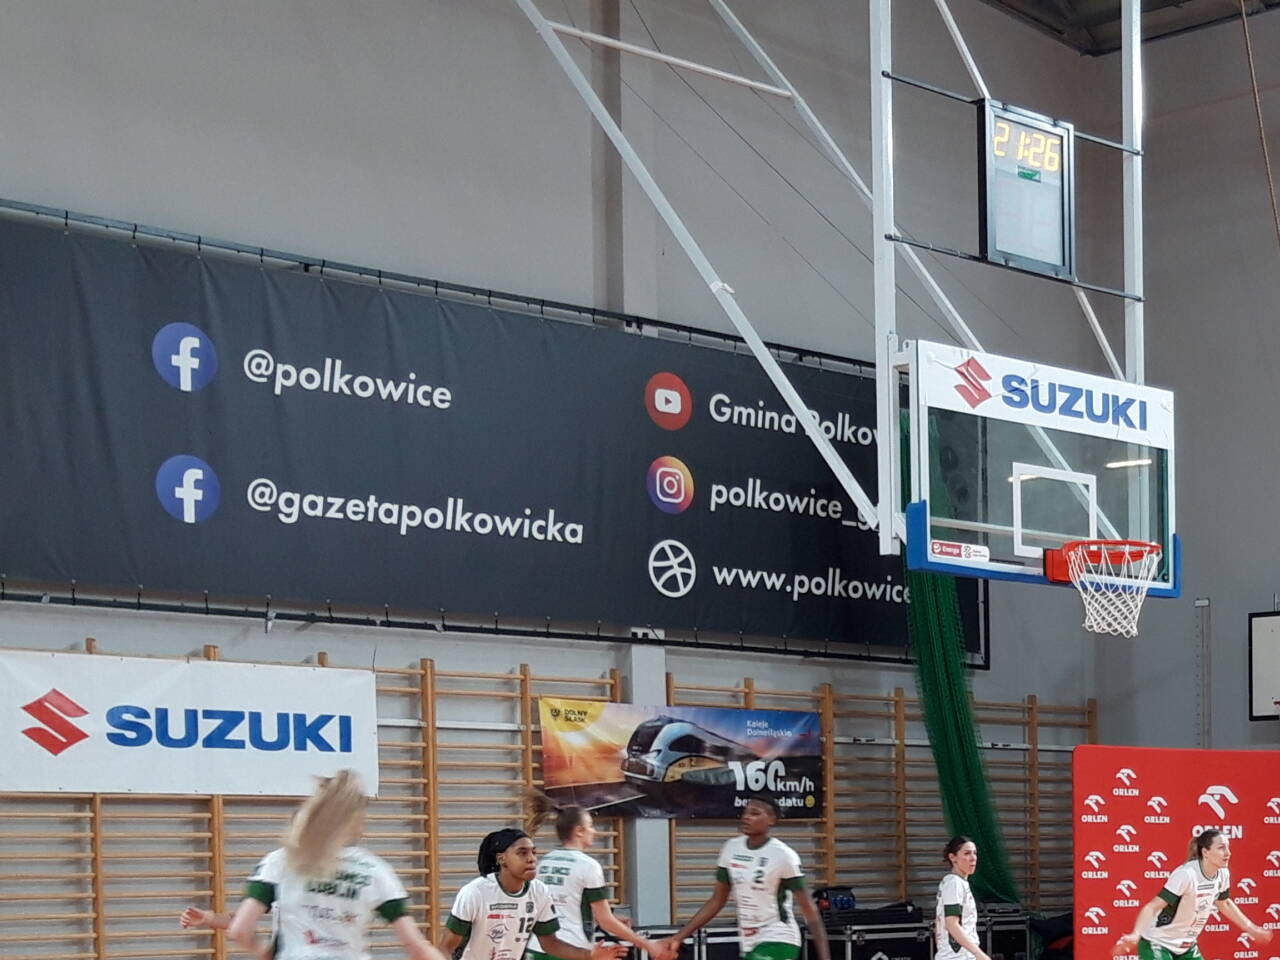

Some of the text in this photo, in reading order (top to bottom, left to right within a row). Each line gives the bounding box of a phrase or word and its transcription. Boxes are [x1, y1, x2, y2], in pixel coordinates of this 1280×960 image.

[992, 122, 1061, 172] 21:26
[243, 348, 452, 410] @polkowice
[1001, 374, 1147, 431] SUZUKI
[709, 393, 797, 434] Gmina
[247, 477, 584, 544] @gazetapolkowicka
[106, 705, 352, 753] SUZUKI
[727, 760, 815, 793] 160 km/h
[1113, 788, 1139, 796] ORLEN
[1205, 924, 1229, 932] ORLEN
